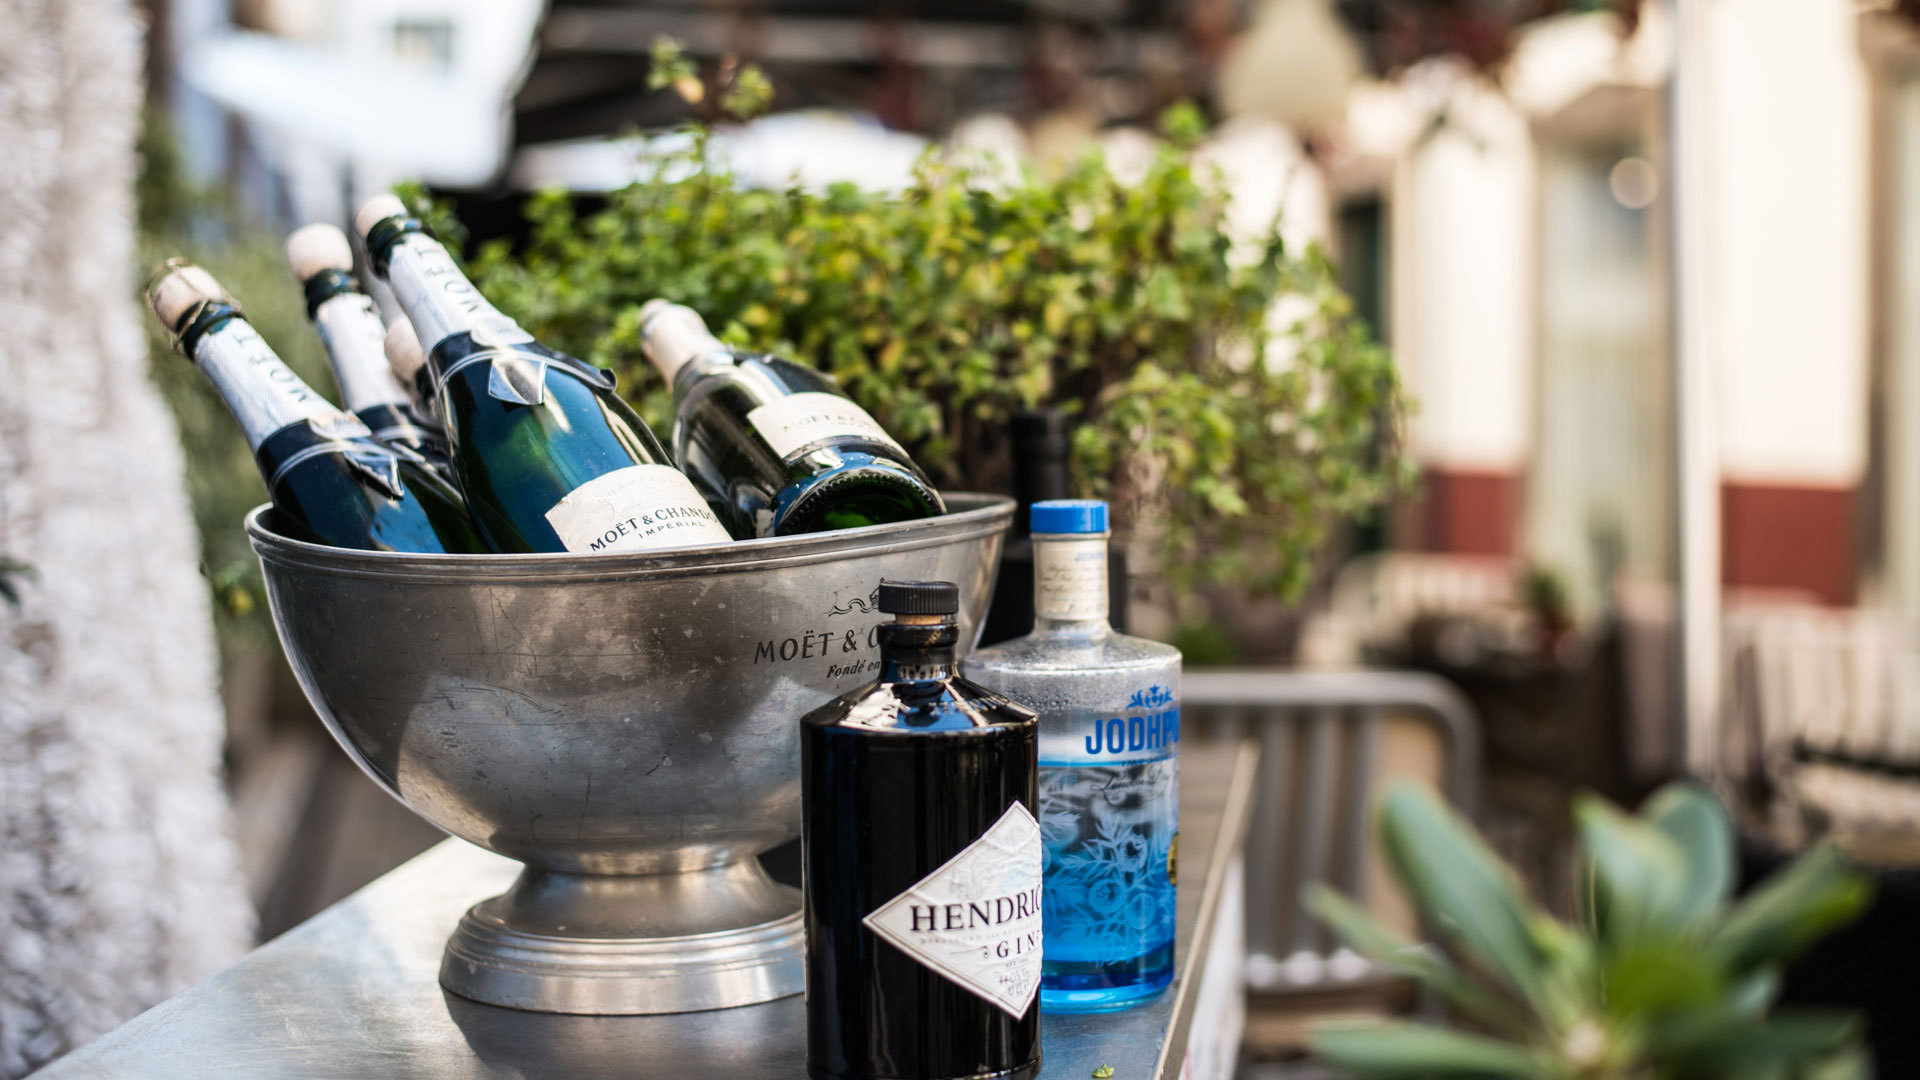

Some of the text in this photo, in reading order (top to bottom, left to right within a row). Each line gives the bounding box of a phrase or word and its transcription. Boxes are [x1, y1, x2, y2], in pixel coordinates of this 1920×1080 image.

[588, 517, 638, 551] MOËT
[642, 515, 653, 525] &
[638, 520, 706, 539] IMPÉRIAL
[754, 630, 834, 665] MOËT
[842, 629, 858, 653] &
[826, 659, 880, 679] Fondé en
[996, 933, 1036, 958] GIN
